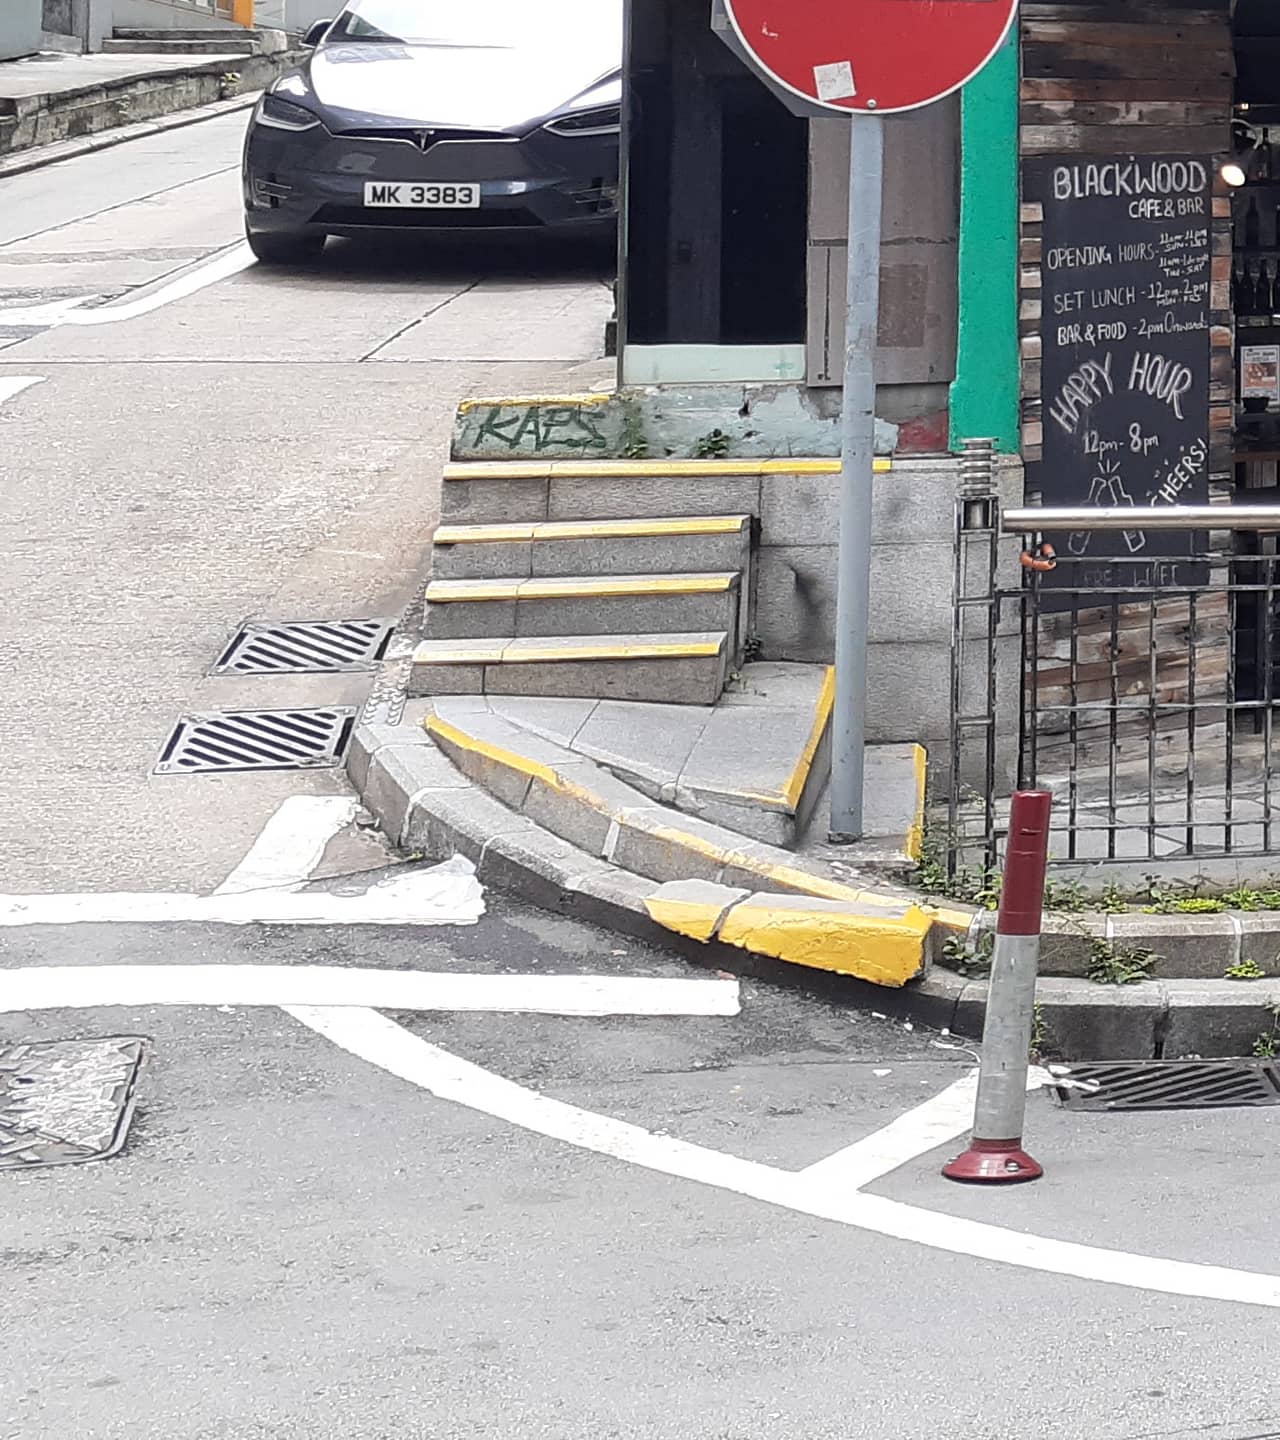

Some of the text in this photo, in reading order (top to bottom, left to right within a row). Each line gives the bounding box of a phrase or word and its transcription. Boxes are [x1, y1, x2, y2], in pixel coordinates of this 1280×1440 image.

[1053, 160, 1207, 200] BLACKWOOD
[371, 185, 473, 205] MK 3383
[1128, 199, 1163, 219] CAFE
[1177, 197, 1205, 215] BAR
[1047, 246, 1112, 270] OPENING
[1054, 290, 1085, 314] SET
[1091, 286, 1136, 308] LUNCH
[1057, 325, 1083, 346] BAR
[1084, 325, 1096, 347] &
[1097, 321, 1128, 341] FOOD
[1050, 351, 1192, 433] HAPPY HOUR
[1128, 422, 1159, 456] 8pm
